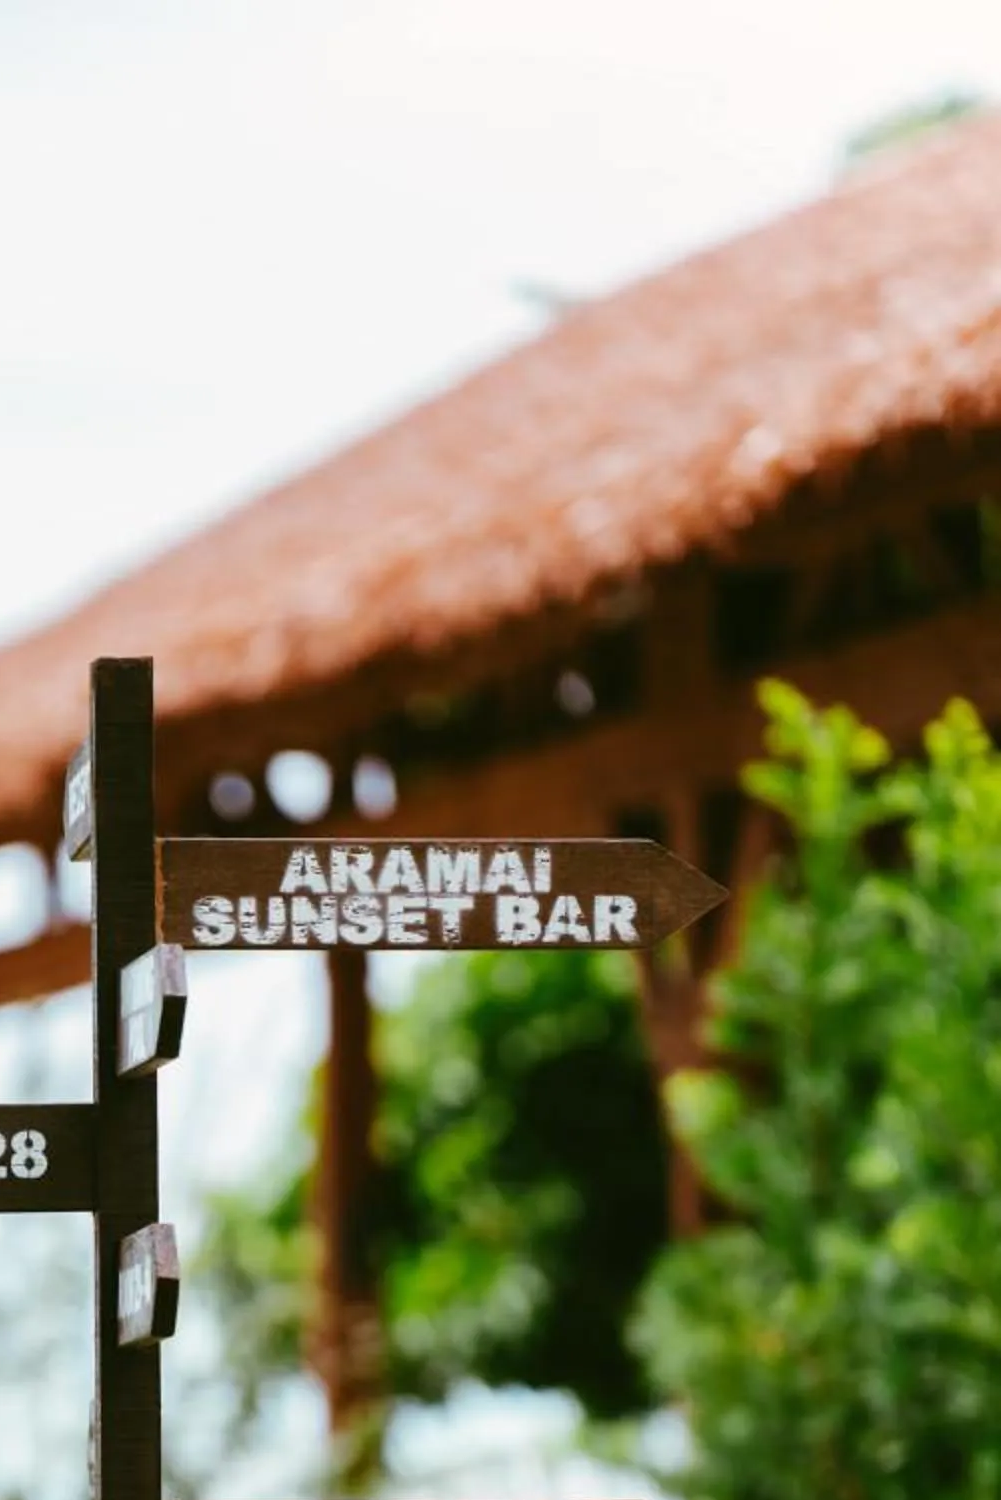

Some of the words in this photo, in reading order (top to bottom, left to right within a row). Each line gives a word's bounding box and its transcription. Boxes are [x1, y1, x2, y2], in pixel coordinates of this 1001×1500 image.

[280, 846, 552, 894] ARAMAI
[192, 895, 475, 945] SUNSET
[496, 894, 639, 946] BAR
